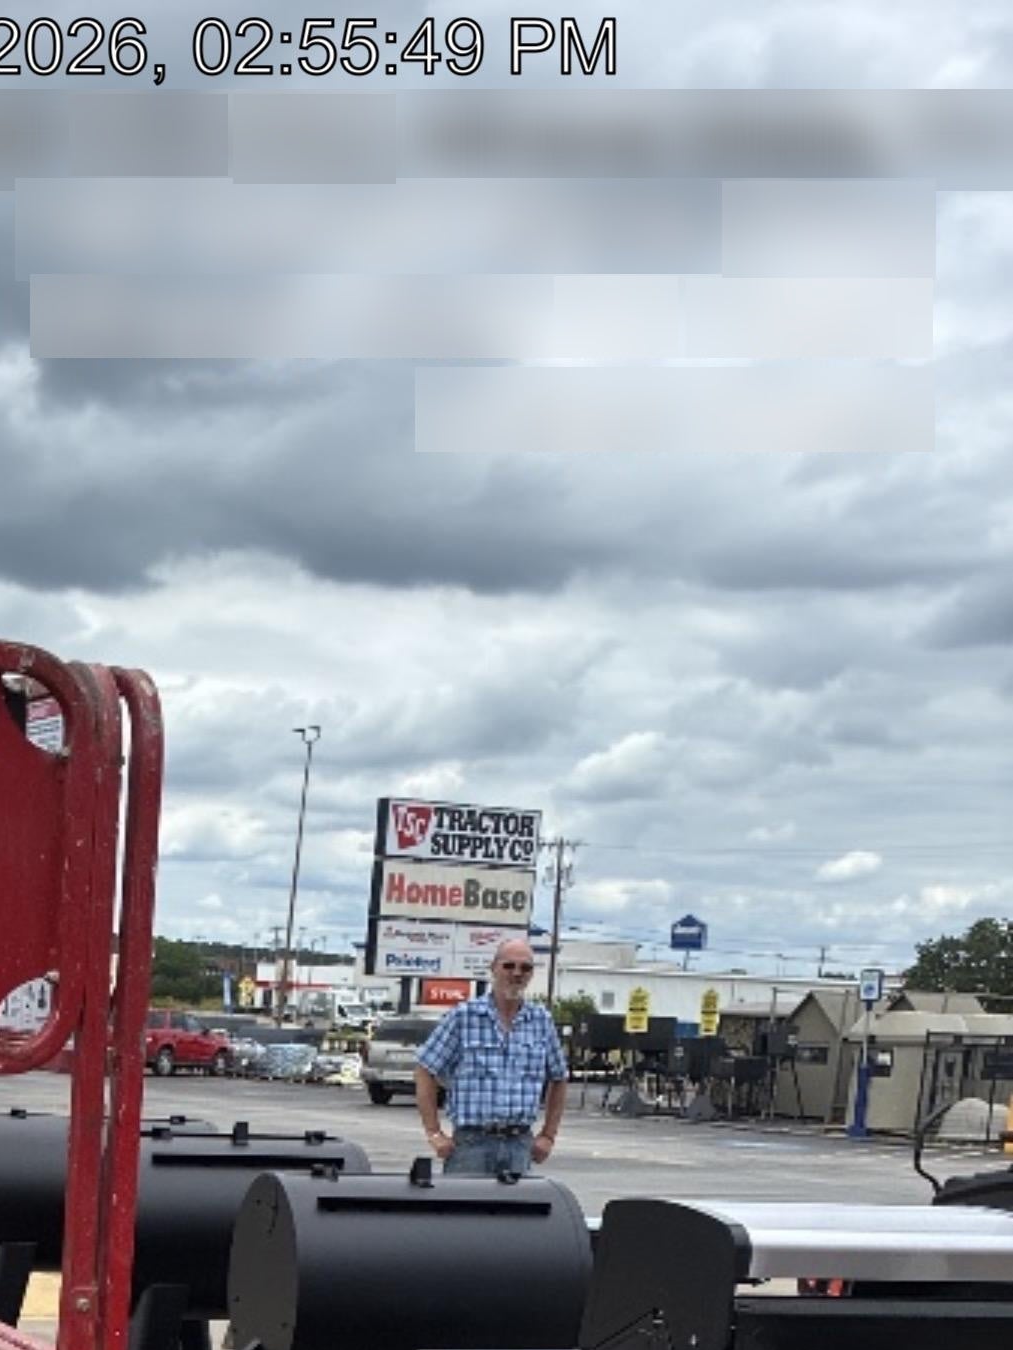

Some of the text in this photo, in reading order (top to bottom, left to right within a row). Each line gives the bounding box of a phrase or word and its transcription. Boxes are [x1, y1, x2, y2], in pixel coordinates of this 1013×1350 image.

[434, 808, 534, 838] TRACTOR
[431, 834, 509, 860] SUPPLY
[387, 872, 526, 911] HomeBase
